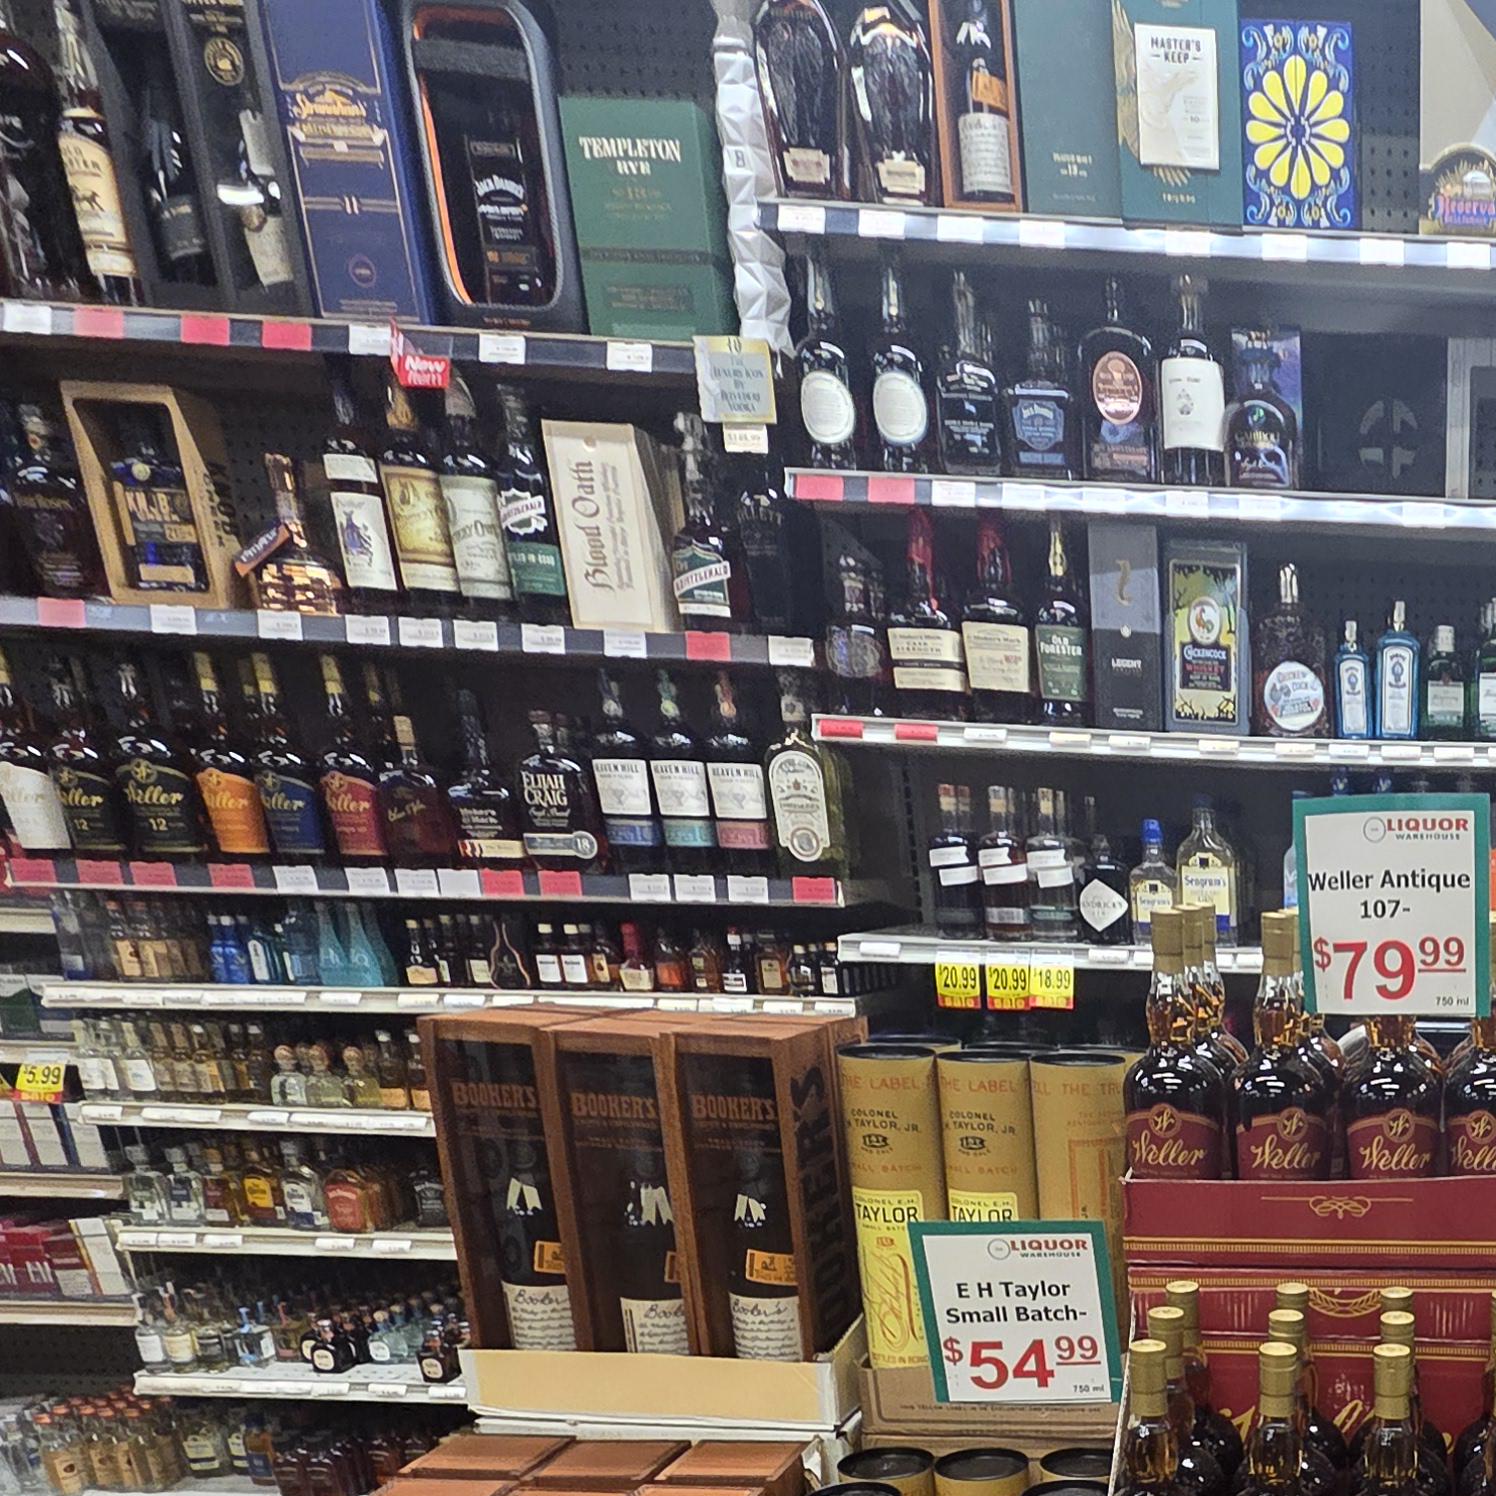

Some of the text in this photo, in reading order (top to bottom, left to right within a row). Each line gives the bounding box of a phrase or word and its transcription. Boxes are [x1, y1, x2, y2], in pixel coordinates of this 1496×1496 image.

[579, 137, 681, 162] TEMPLETON
[405, 355, 445, 373] New
[521, 771, 564, 791] ELIJAH
[524, 787, 567, 807] CRAIG
[1387, 818, 1468, 832] LIQUOR
[1308, 868, 1470, 893] Weller Antique
[1360, 899, 1410, 919] 107-
[938, 966, 977, 990] $20.99
[989, 968, 1028, 991] $20.99
[1435, 996, 1469, 1007] 750 ml
[23, 1065, 62, 1086] $5.99
[1132, 1133, 1208, 1166] Weller
[1250, 1136, 1322, 1171] Weller
[1359, 1136, 1432, 1171] Weller
[857, 1205, 919, 1224] TAYLOR
[1010, 1239, 1088, 1250] LIQUOR
[956, 1281, 1071, 1301] E H Taylor
[946, 1305, 1087, 1324] Small Batch-
